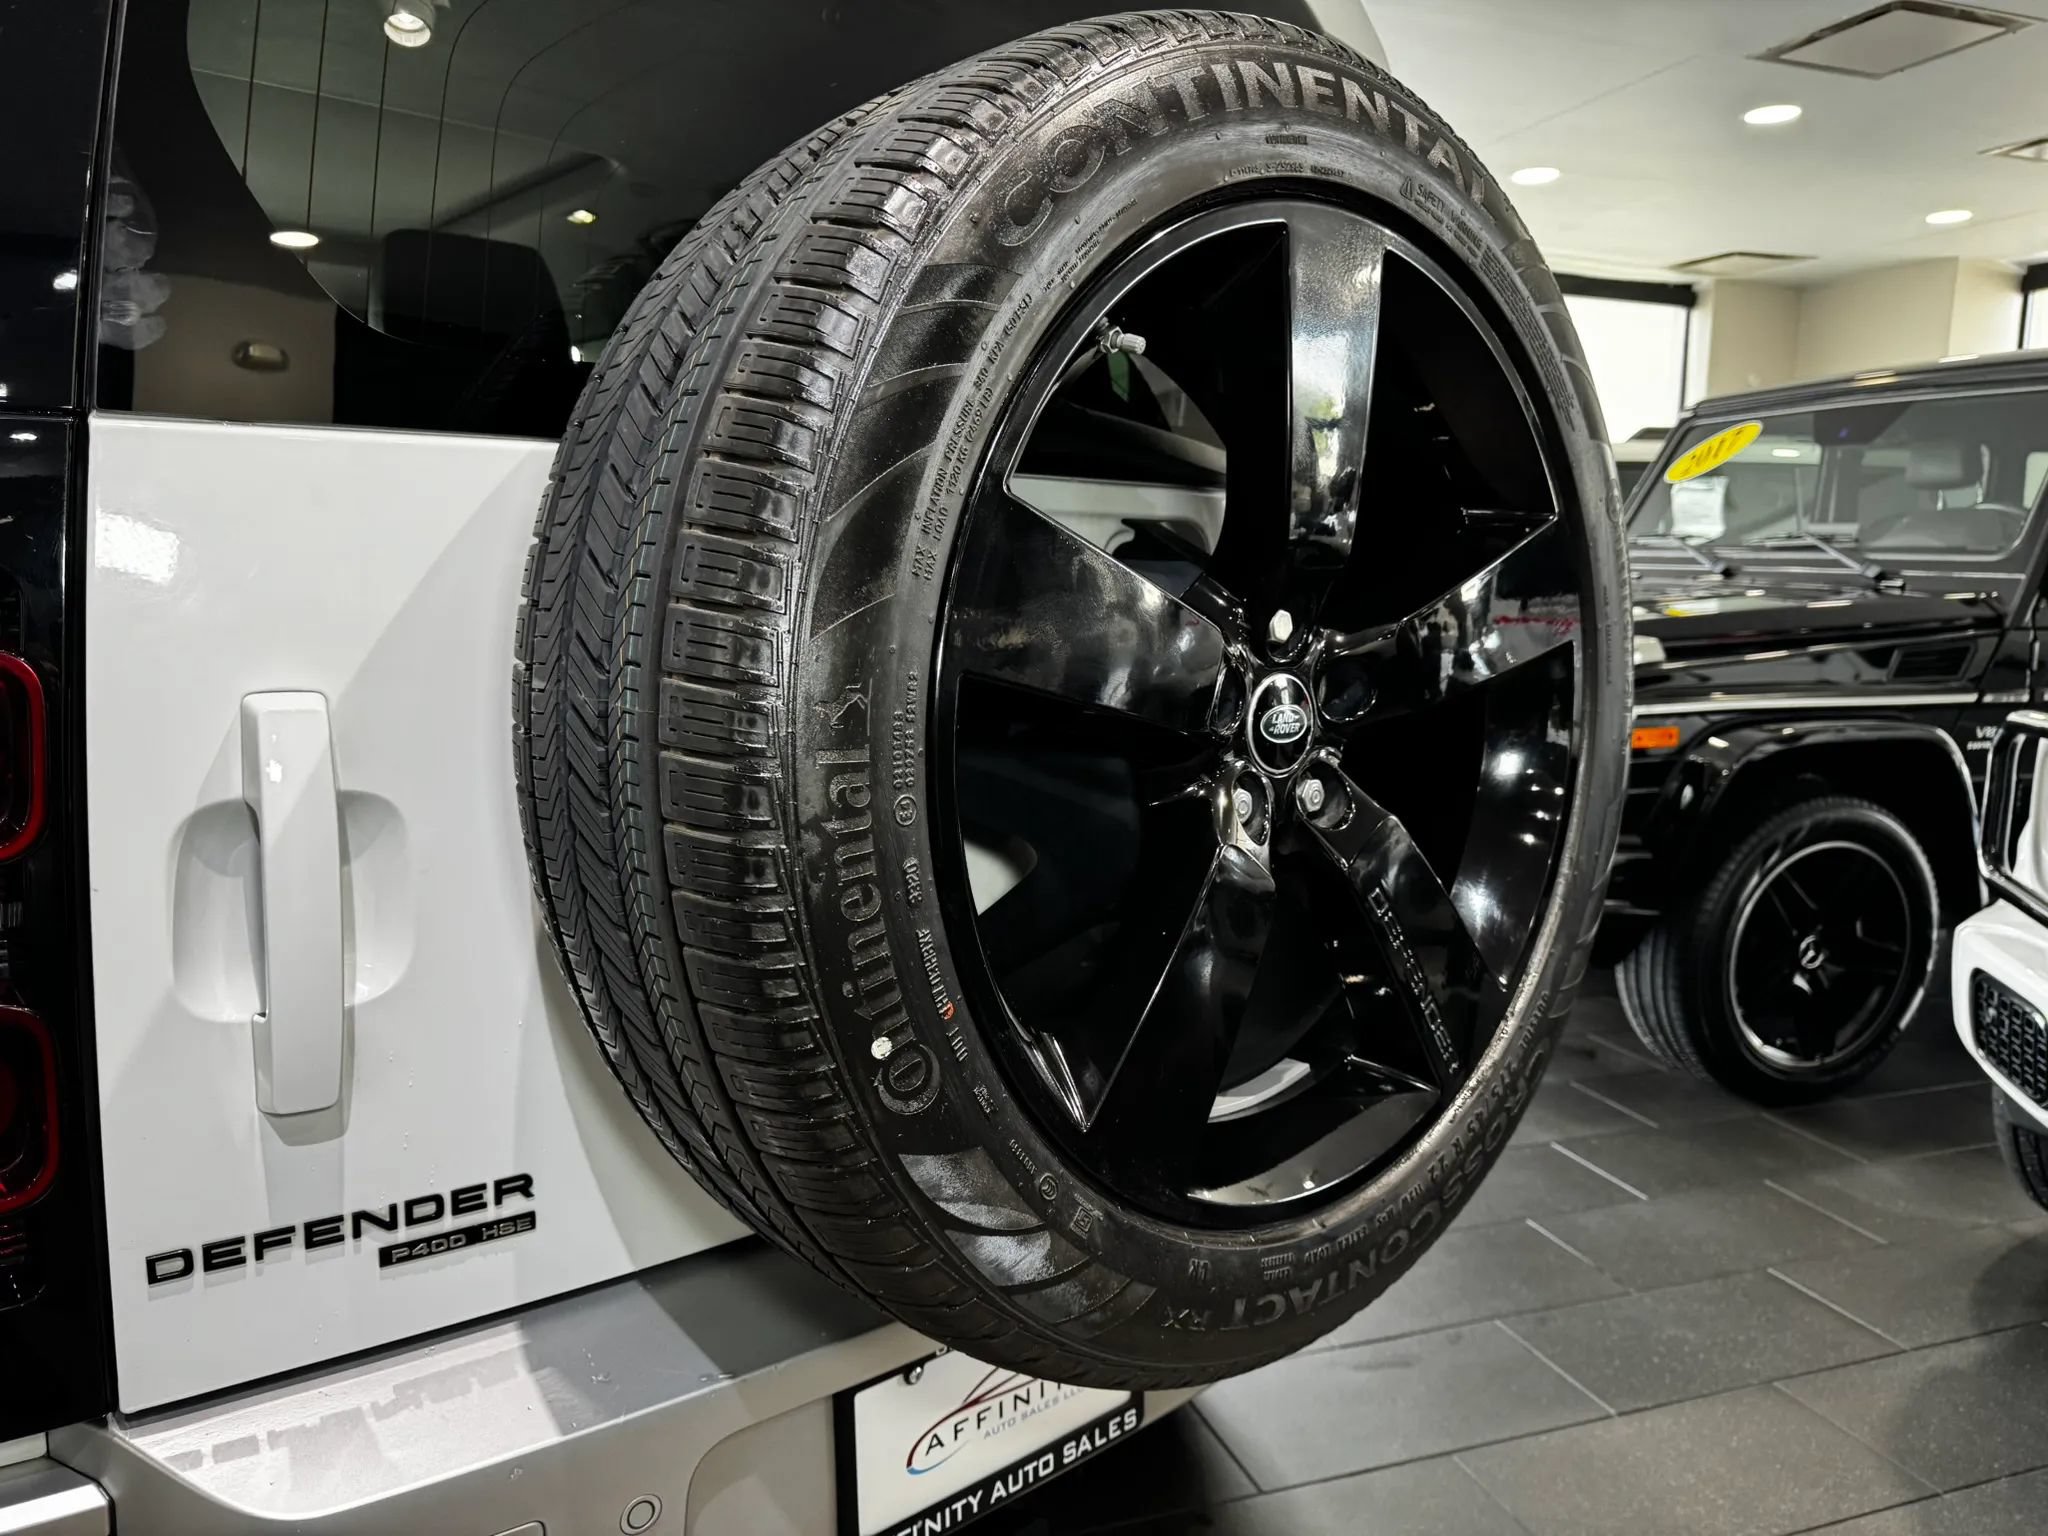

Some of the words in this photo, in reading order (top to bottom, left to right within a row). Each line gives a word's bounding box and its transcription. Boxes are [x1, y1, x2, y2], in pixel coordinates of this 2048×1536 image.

[1000, 60, 1498, 246] CONTINENTAL
[1271, 712, 1294, 724] LAND
[1273, 722, 1301, 734] ROVER
[813, 742, 942, 1116] Continental
[145, 1172, 535, 1286] DEFENDER
[390, 1232, 467, 1264] P400
[481, 1214, 532, 1240] HSE
[924, 1380, 1062, 1456] AFFINI
[983, 1416, 1017, 1440] AUTO
[1020, 1396, 1060, 1420] SALES
[990, 1452, 1055, 1504] AUTO
[1062, 1407, 1138, 1465] SALES
